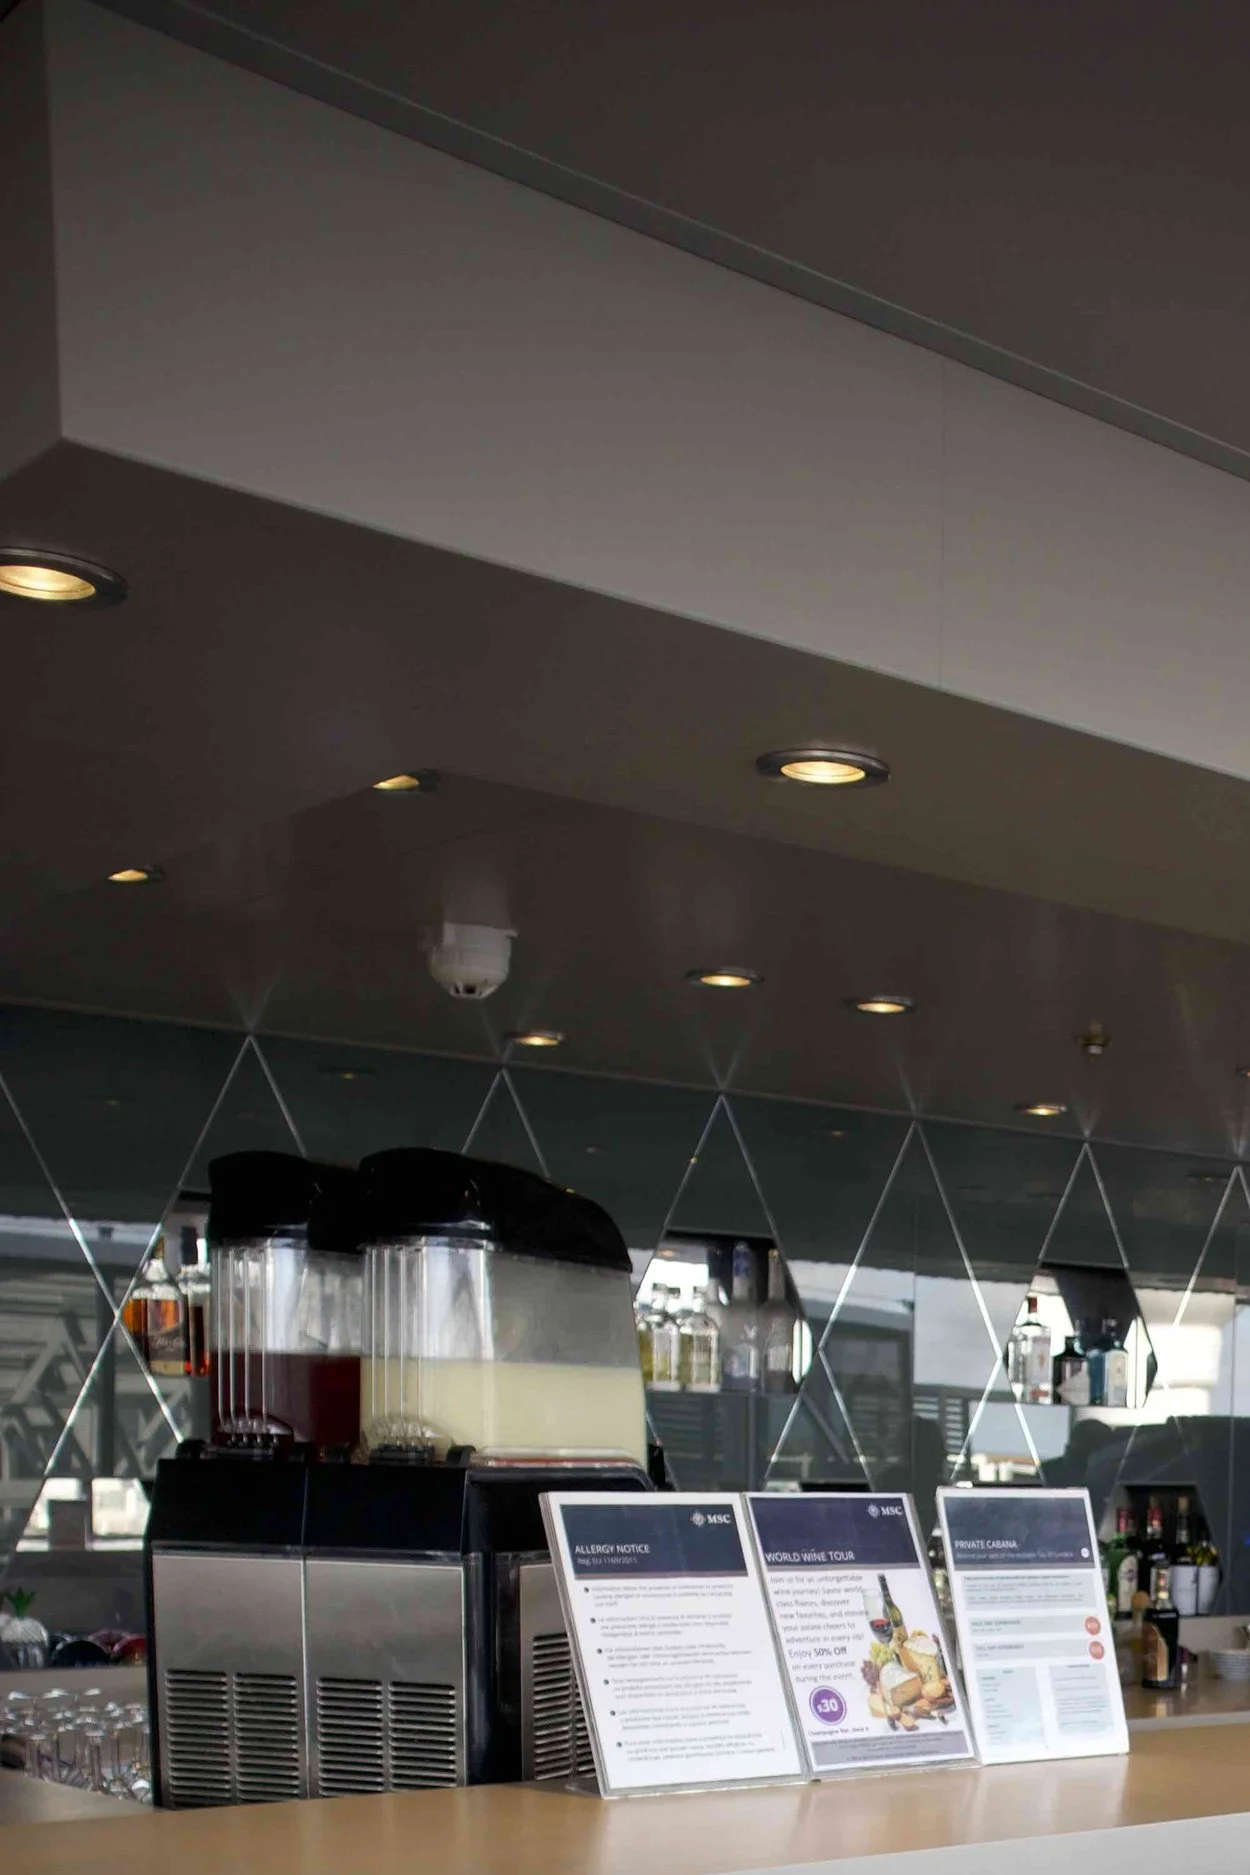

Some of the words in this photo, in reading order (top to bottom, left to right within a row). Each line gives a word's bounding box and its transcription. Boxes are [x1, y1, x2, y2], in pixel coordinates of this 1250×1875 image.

[880, 1506, 903, 1515] MSC
[707, 1514, 731, 1524] MSC
[575, 1544, 615, 1554] ALLERGY
[616, 1544, 650, 1554] NOTICE
[954, 1540, 986, 1549] PRIVATE
[987, 1540, 1018, 1549] CABANA
[765, 1551, 800, 1562] WORLD
[801, 1551, 827, 1562] WINE
[828, 1551, 856, 1561] TOUR
[788, 1648, 812, 1659] Enjoy
[813, 1647, 832, 1657] 50%
[833, 1646, 847, 1656] Off
[824, 1660, 856, 1670] purchase
[795, 1674, 818, 1684] during
